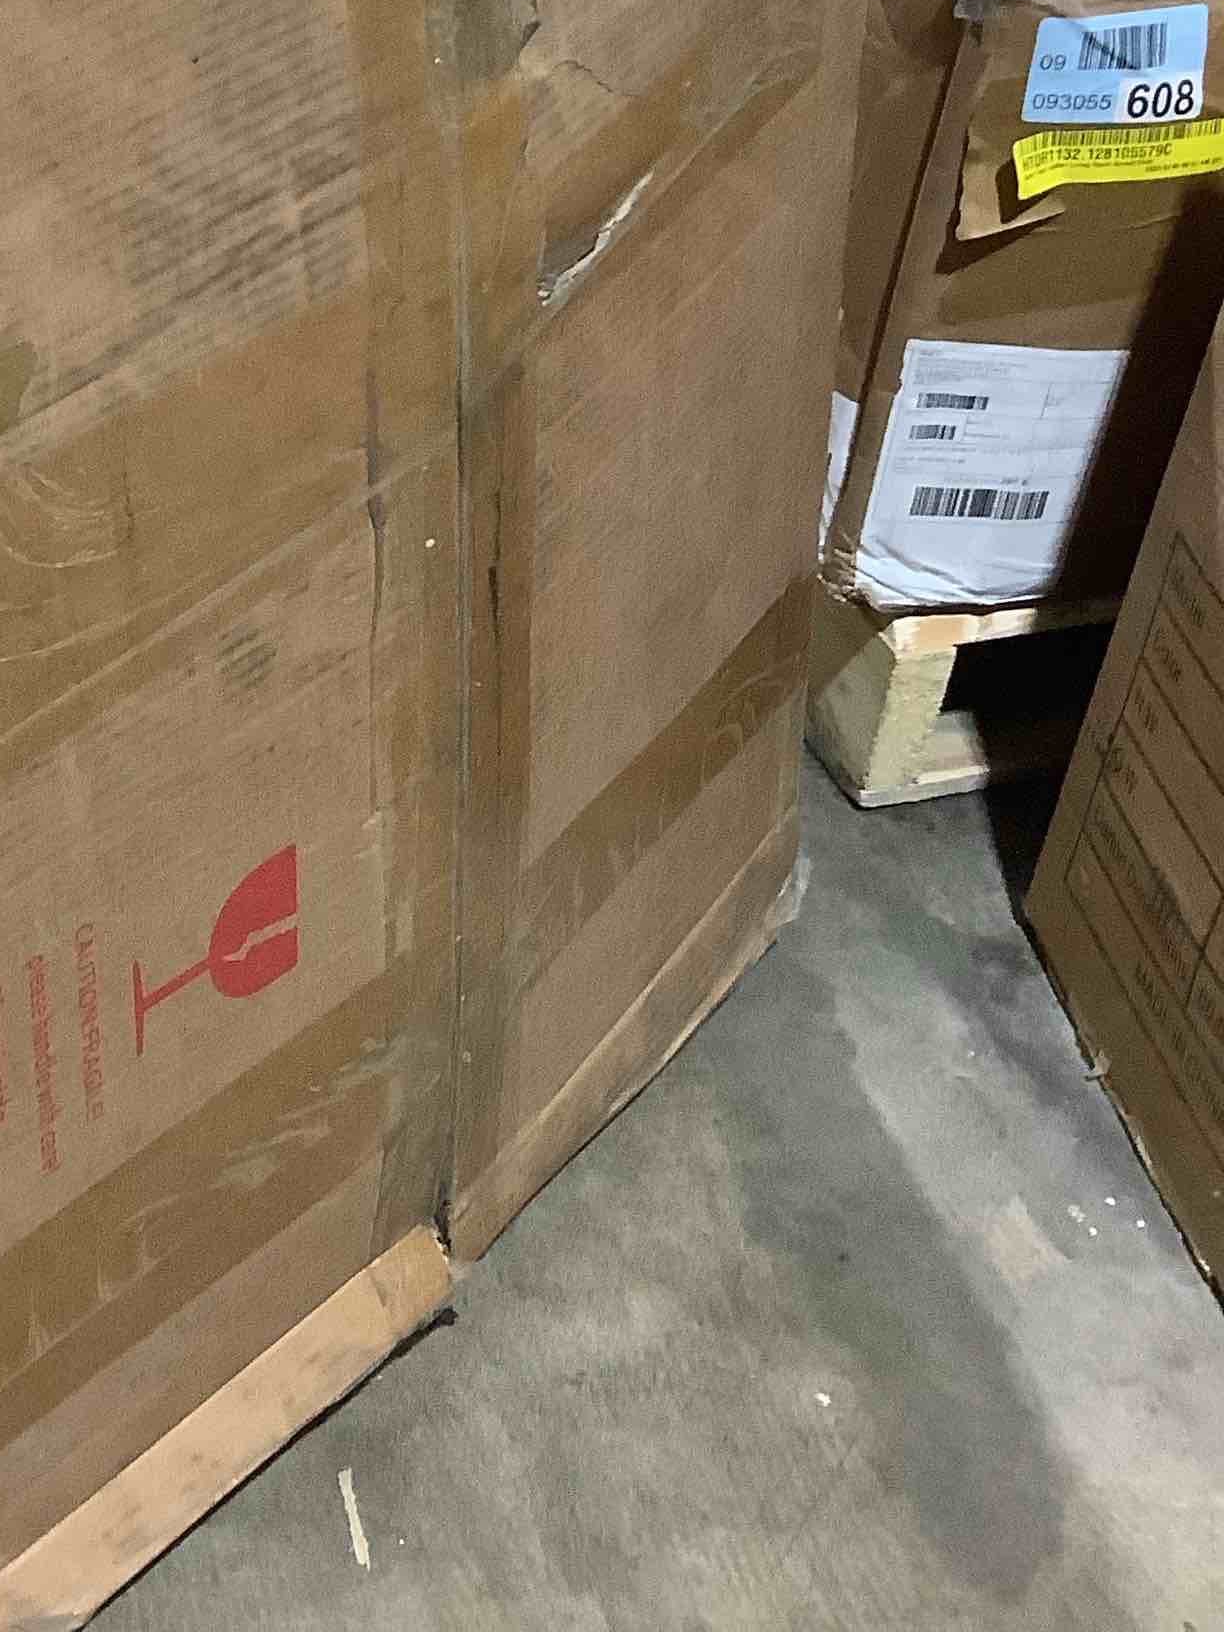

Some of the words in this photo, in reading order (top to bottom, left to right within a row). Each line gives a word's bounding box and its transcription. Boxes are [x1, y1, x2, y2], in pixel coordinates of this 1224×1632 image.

[1039, 53, 1067, 72] 09
[1032, 93, 1113, 112] 093055
[1127, 79, 1195, 119] 608
